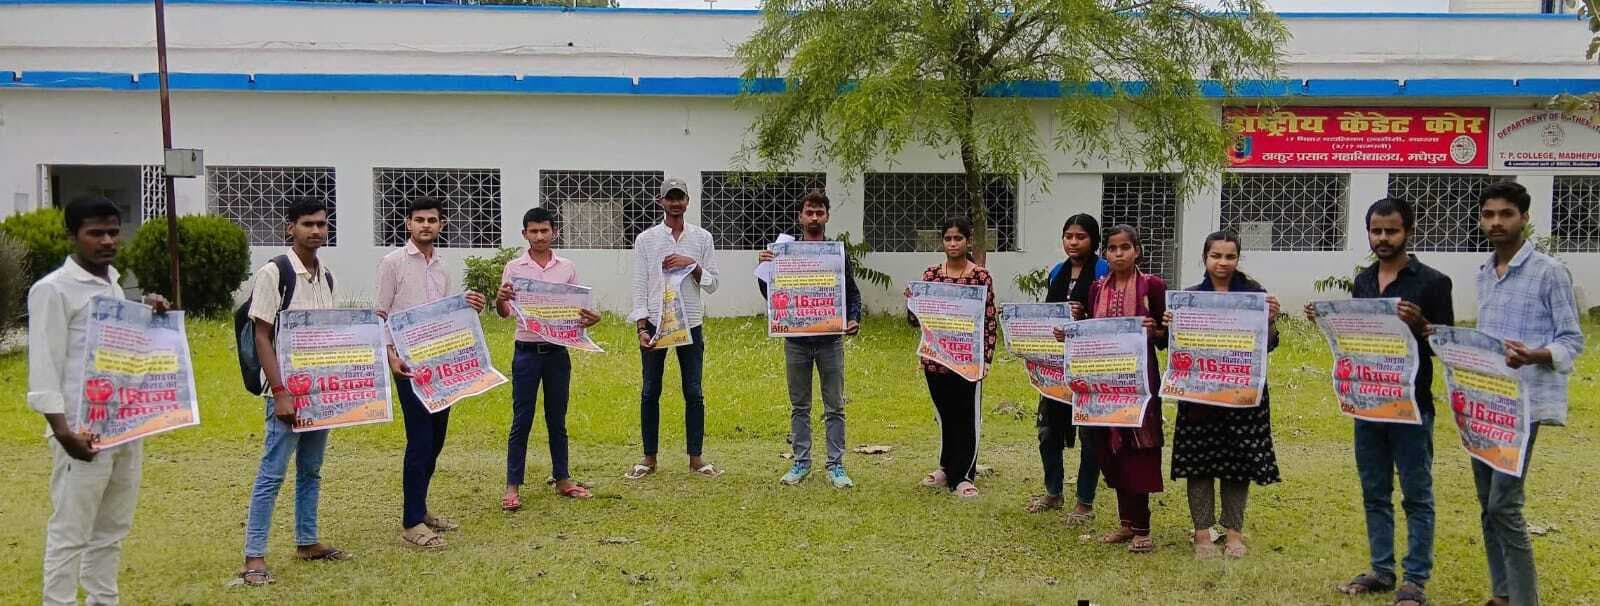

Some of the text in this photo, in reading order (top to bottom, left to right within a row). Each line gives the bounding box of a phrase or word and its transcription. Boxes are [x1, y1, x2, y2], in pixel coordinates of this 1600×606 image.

[1423, 112, 1484, 133] कोर
[1497, 112, 1547, 139] DEPARTMENT
[1549, 112, 1559, 120] OF
[1262, 152, 1293, 163] ठाकुर
[1331, 150, 1404, 162] महाविद्यालय,
[1500, 152, 1506, 160] T.
[1509, 152, 1516, 160] P.
[1517, 152, 1556, 160] COLLEGE,
[795, 295, 809, 308] 16
[437, 365, 453, 380] 16
[1197, 357, 1217, 373] 16
[1356, 364, 1373, 381] 16
[316, 376, 339, 392] 16
[1468, 401, 1486, 420] 16
